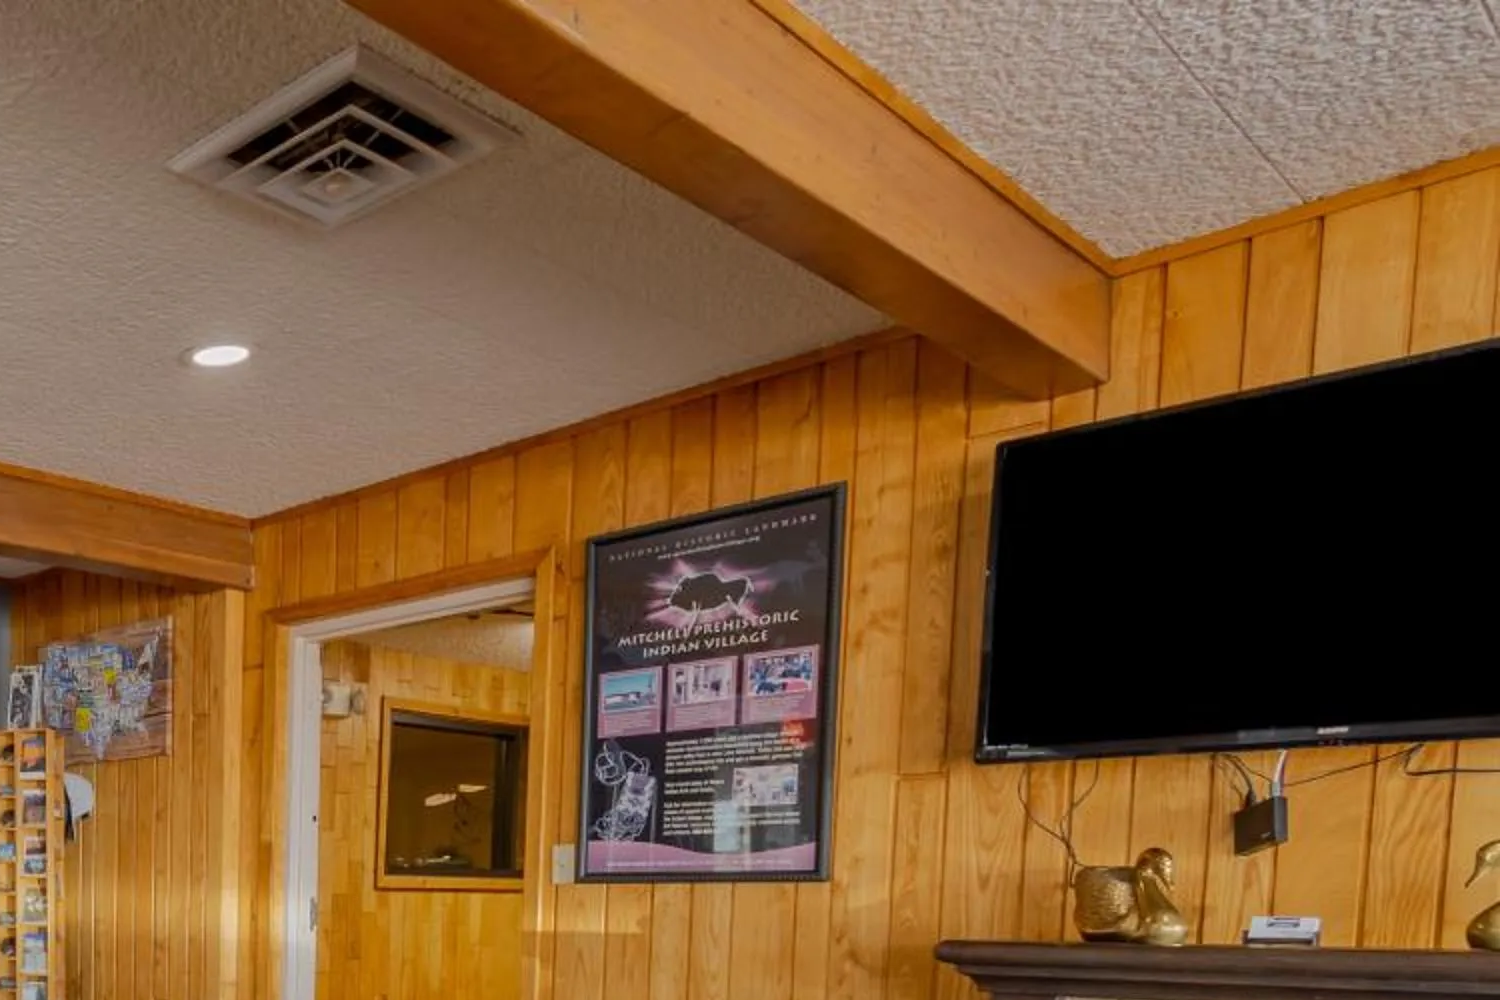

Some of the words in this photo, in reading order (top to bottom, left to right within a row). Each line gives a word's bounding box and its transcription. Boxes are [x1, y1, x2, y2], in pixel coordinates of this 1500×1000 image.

[617, 626, 691, 648] MITCHELL
[694, 609, 800, 636] PREHISTORIC
[643, 641, 700, 659] INDIAN
[704, 629, 769, 649] VILLAGE
